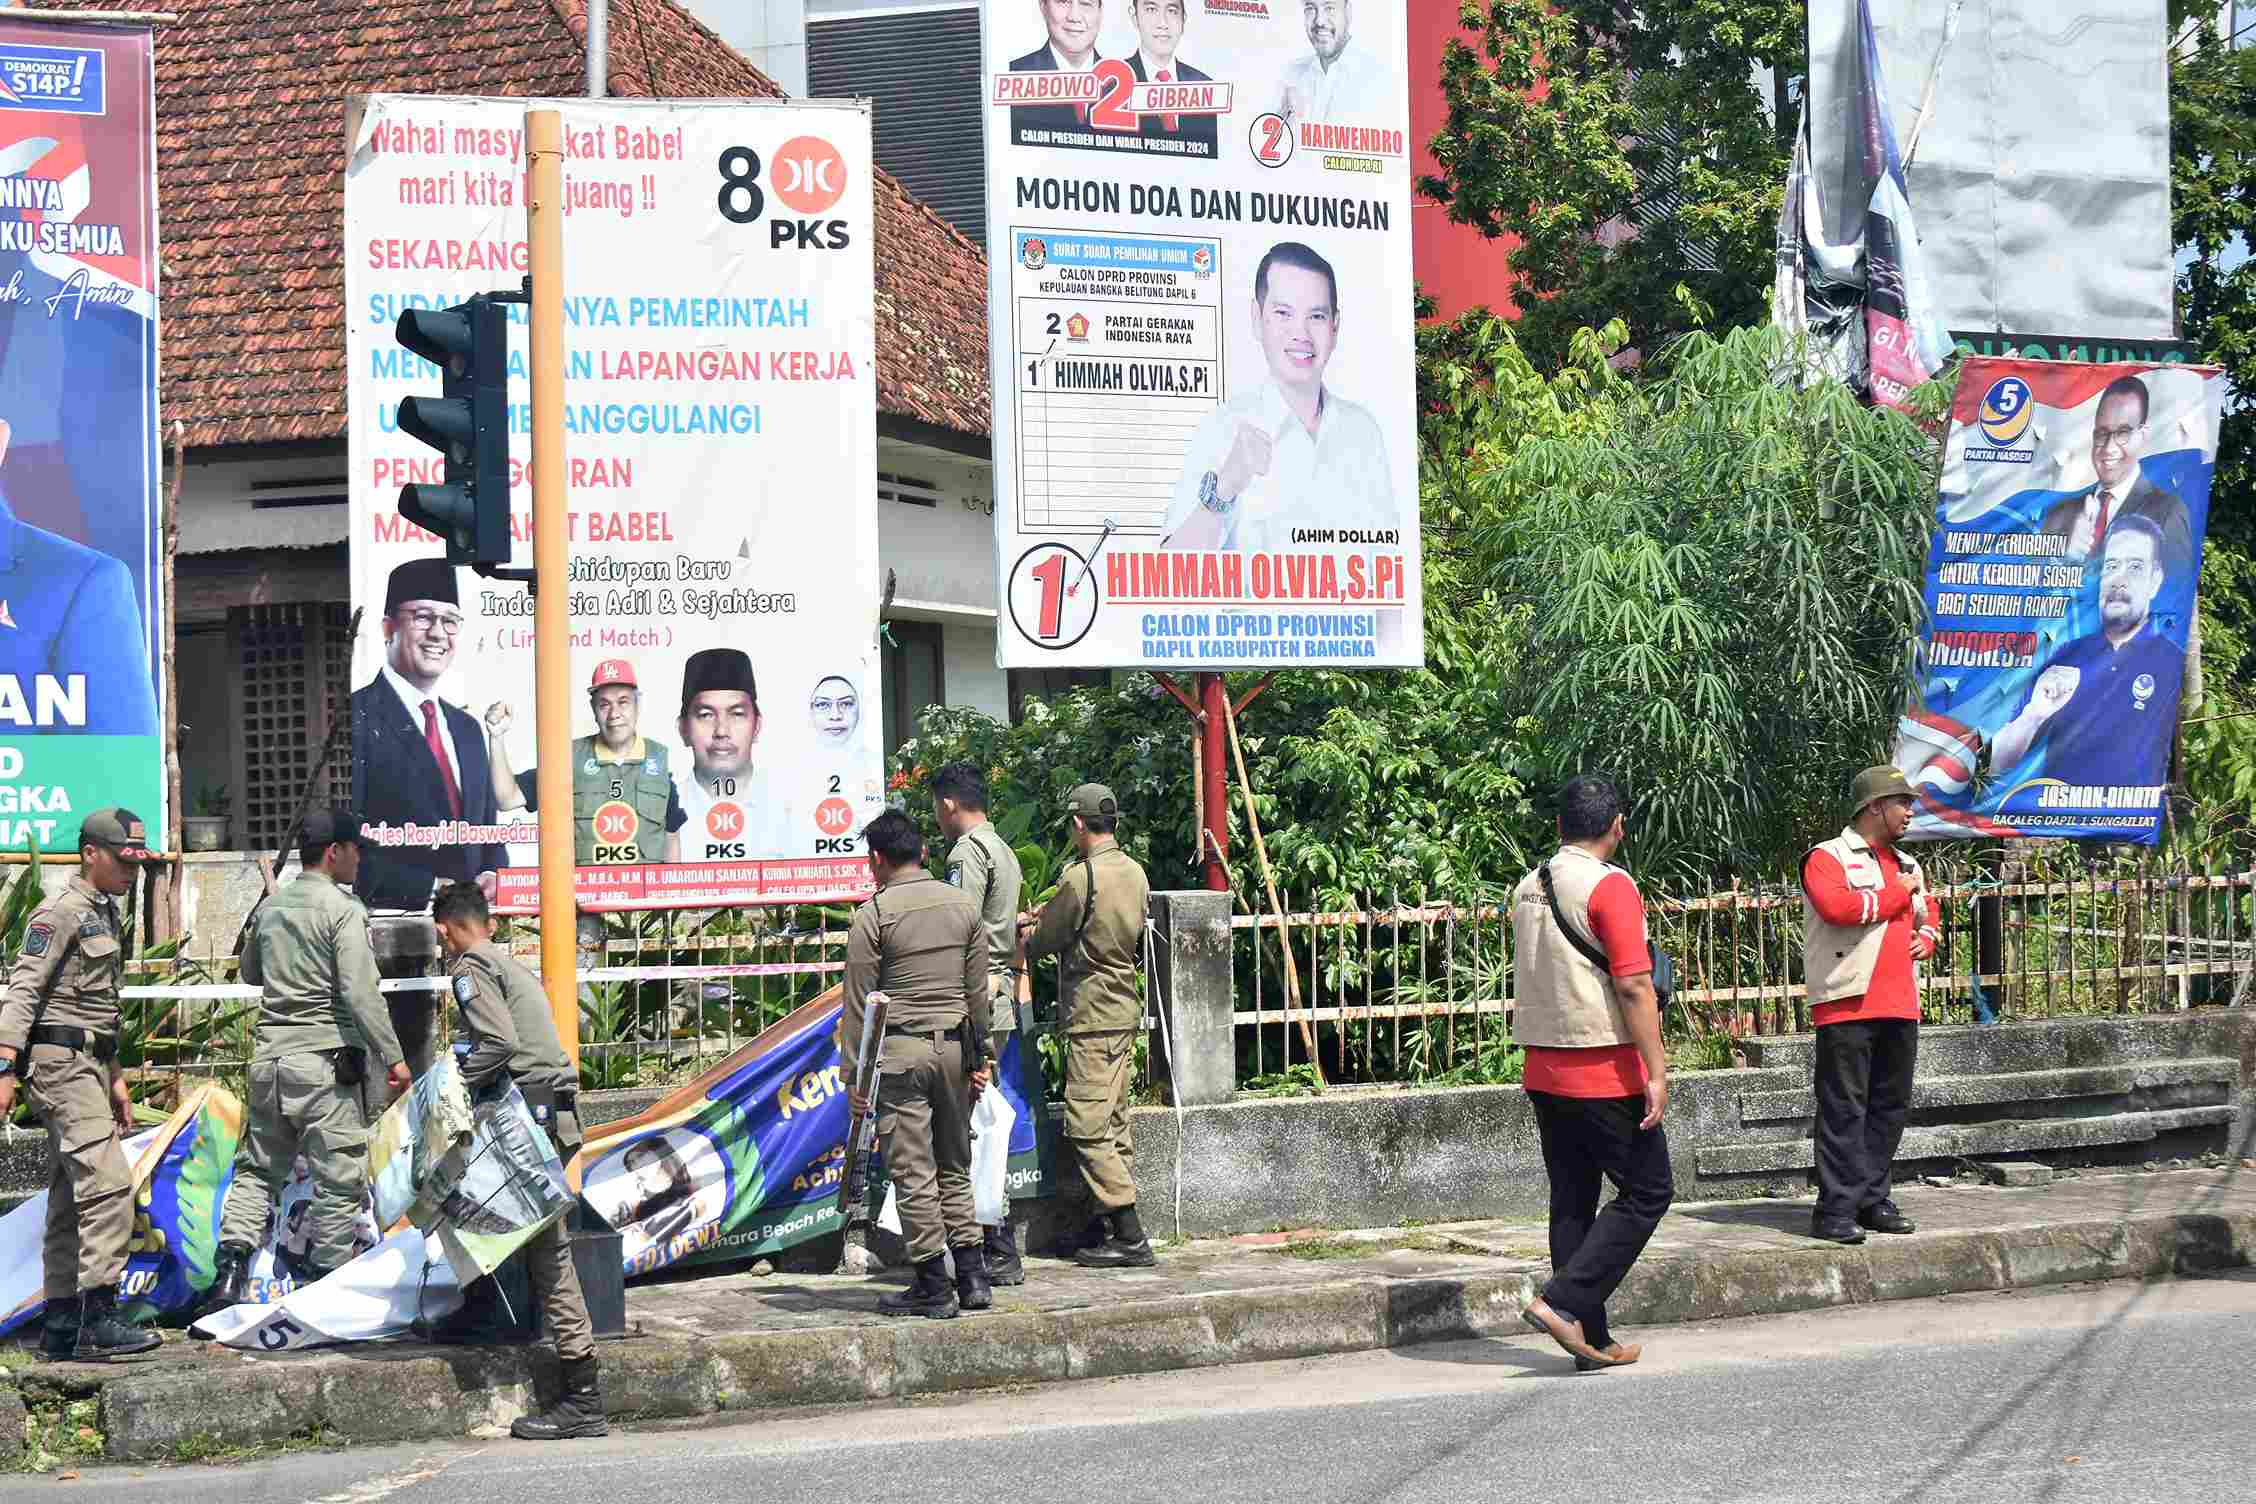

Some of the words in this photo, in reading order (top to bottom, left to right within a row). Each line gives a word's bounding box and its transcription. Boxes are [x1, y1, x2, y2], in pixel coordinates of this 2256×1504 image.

[5, 61, 71, 75] DEMOKRAT
[13, 57, 87, 97] S14P!
[998, 75, 1095, 99] PRABOWO
[1146, 87, 1214, 109] GIBRAN
[1090, 58, 1139, 130] 2
[371, 118, 444, 155] Wahai
[615, 125, 683, 160] Babel
[1020, 129, 1050, 144] CALON
[1051, 131, 1094, 146] PRESIDEN
[1095, 134, 1114, 148] DAN
[1115, 136, 1143, 150] WAKIL
[1144, 138, 1185, 153] PRESIDEN
[1186, 141, 1209, 155] 2024
[1259, 116, 1282, 161] 2
[1300, 122, 1404, 154] HARWENDRO
[400, 170, 455, 206] mari
[464, 170, 513, 207] kita
[641, 174, 656, 210] !!
[718, 146, 764, 224] 8
[1016, 176, 1120, 213] MOHON
[1129, 183, 1182, 218] DOA
[1191, 187, 1242, 222] DAN
[1250, 191, 1390, 231] DUKUNGAN
[40, 223, 125, 256] SEMUA
[770, 219, 850, 250] PKS
[368, 239, 529, 271] SEKARANG
[1053, 243, 1081, 258] SURAT
[1083, 244, 1112, 260] SUARA
[1113, 247, 1159, 263] PEMILIHAN
[1160, 250, 1188, 264] UMUM
[1059, 268, 1095, 282] CALON
[1097, 269, 1126, 284] DPRD
[1129, 271, 1177, 286] PROVINSI
[45, 269, 134, 321] Amin
[1039, 281, 1089, 294] KEPULAUAN
[1090, 283, 1123, 297] BANGKA
[1125, 285, 1164, 299] BELITUNG
[1165, 287, 1188, 300] DAPIL
[629, 297, 808, 327] PEMERINTAH
[1046, 312, 1061, 335] 2
[1105, 315, 1143, 329] PARTAI
[1146, 317, 1194, 331] GERAKAN
[1105, 330, 1162, 344] INDONESIA
[1165, 331, 1193, 345] RAYA
[601, 350, 761, 381] LAPANGAN
[770, 350, 856, 381] KERJA
[1028, 360, 1038, 386] 1
[1055, 361, 1123, 390] HIMMAH
[1129, 363, 1208, 396] OLVIA,S.Pi
[2000, 383, 2019, 412] 5
[1964, 448, 1996, 462] PARTAI
[1997, 450, 2033, 464] NASDEM
[588, 511, 673, 542] BABEL
[1291, 527, 1335, 544] (AHIM
[1339, 528, 1400, 545] DOLLAR)
[1945, 532, 1995, 555] MENUJU
[1997, 533, 2067, 557] PERUBAHAN
[569, 555, 671, 588] ehidupan
[675, 555, 732, 582] Baru
[1107, 552, 1242, 598] HIMMAH
[1251, 553, 1404, 604] OLVIA,S.Pi
[1939, 562, 1980, 585] UNTUK
[1982, 563, 2041, 587] KEADILAN
[2043, 565, 2084, 588] SOSIAL
[480, 589, 600, 617] Indosia
[606, 588, 652, 616] Adil
[658, 588, 677, 615] &
[682, 589, 797, 621] Sejahtera
[1032, 554, 1067, 640] 1
[1936, 592, 1967, 616] BAGI
[1968, 594, 2022, 617] SELURUH
[2023, 595, 2071, 618] RAKYAT
[600, 627, 659, 648] Match
[1142, 614, 1210, 637] CALON
[1216, 615, 1272, 636] DPRD
[1278, 615, 1375, 636] PROVINSI
[1142, 639, 1195, 658] DAPIL
[1199, 639, 1299, 658] KABUPATEN
[1304, 640, 1376, 658] BANGKA
[1928, 631, 2038, 668] INDONESIA
[610, 781, 622, 799] 5
[712, 779, 736, 797] 10
[829, 775, 841, 794] 2
[1992, 815, 2043, 826] BACALEG
[2044, 816, 2077, 827] DAPIL
[404, 820, 458, 850] Rasyid
[459, 821, 540, 845] Baswedan
[816, 838, 854, 853] PKS
[595, 846, 637, 862] PKS
[706, 844, 746, 859] PKS
[716, 868, 759, 882] SANJAYA
[762, 1211, 815, 1237] Beach
